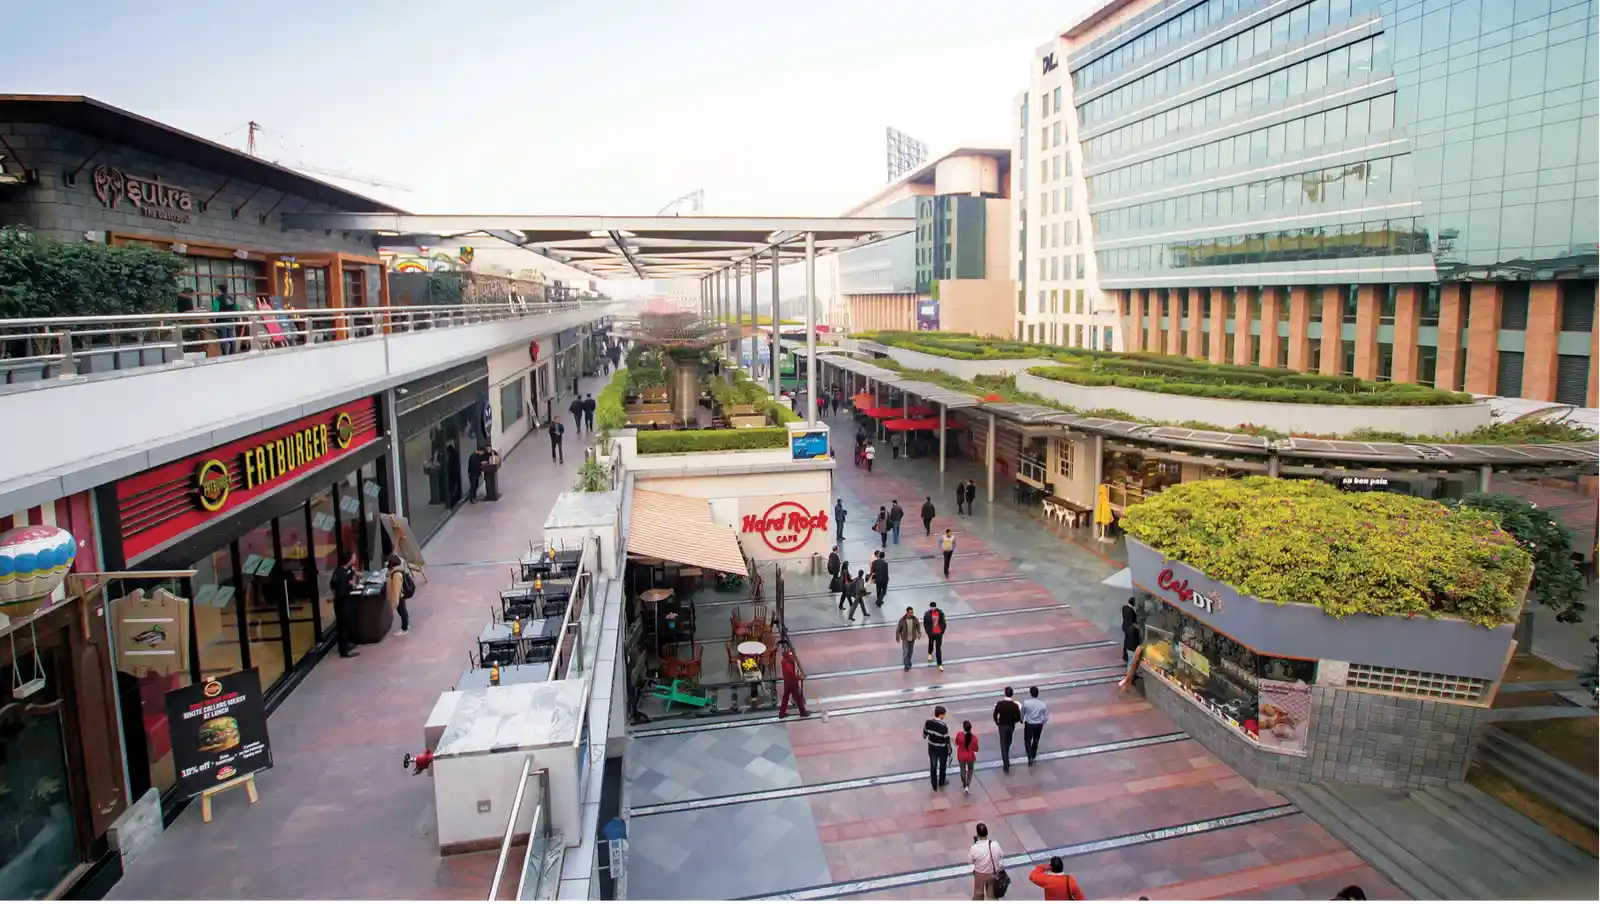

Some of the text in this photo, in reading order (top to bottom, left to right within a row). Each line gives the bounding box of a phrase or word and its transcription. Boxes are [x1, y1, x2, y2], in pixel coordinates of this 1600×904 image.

[245, 423, 329, 490] FATBURGER
[1354, 477, 1369, 485] bon
[1370, 477, 1388, 486] pain
[742, 510, 829, 533] Hard Rock
[776, 535, 797, 543] CAFE
[183, 708, 203, 720] WHITE
[203, 700, 227, 713] COLLARS
[227, 694, 247, 706] MESSY
[203, 707, 229, 720] AT LUNCH
[182, 765, 199, 778] 10%
[199, 760, 211, 771] off
